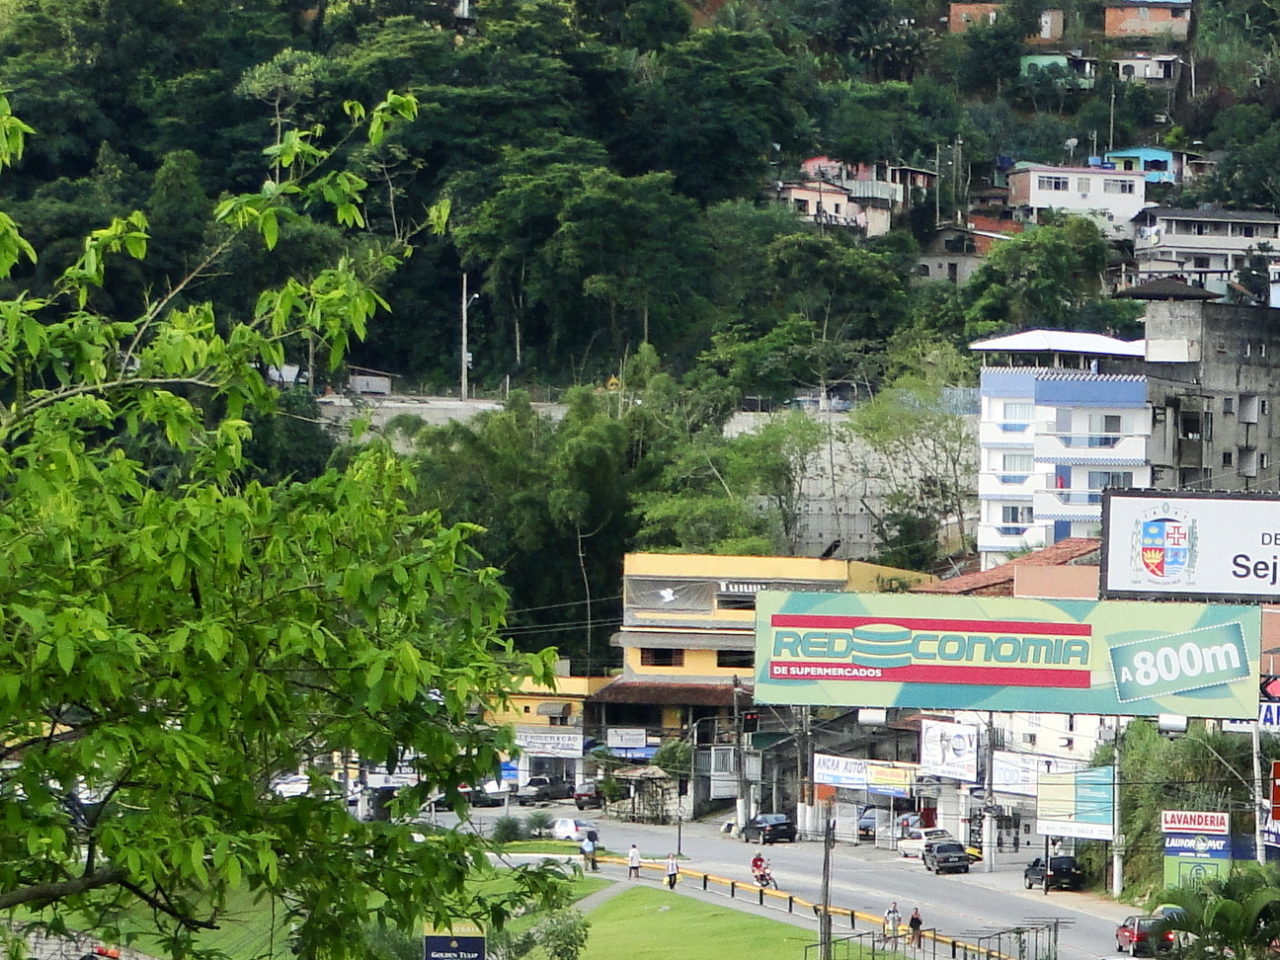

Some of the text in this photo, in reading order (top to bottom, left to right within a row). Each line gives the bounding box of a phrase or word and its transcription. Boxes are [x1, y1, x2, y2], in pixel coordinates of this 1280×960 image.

[1121, 642, 1241, 686] A 800m
[773, 666, 882, 678] DE SUPERMERCADOS
[1164, 813, 1226, 827] LAVANDERIA
